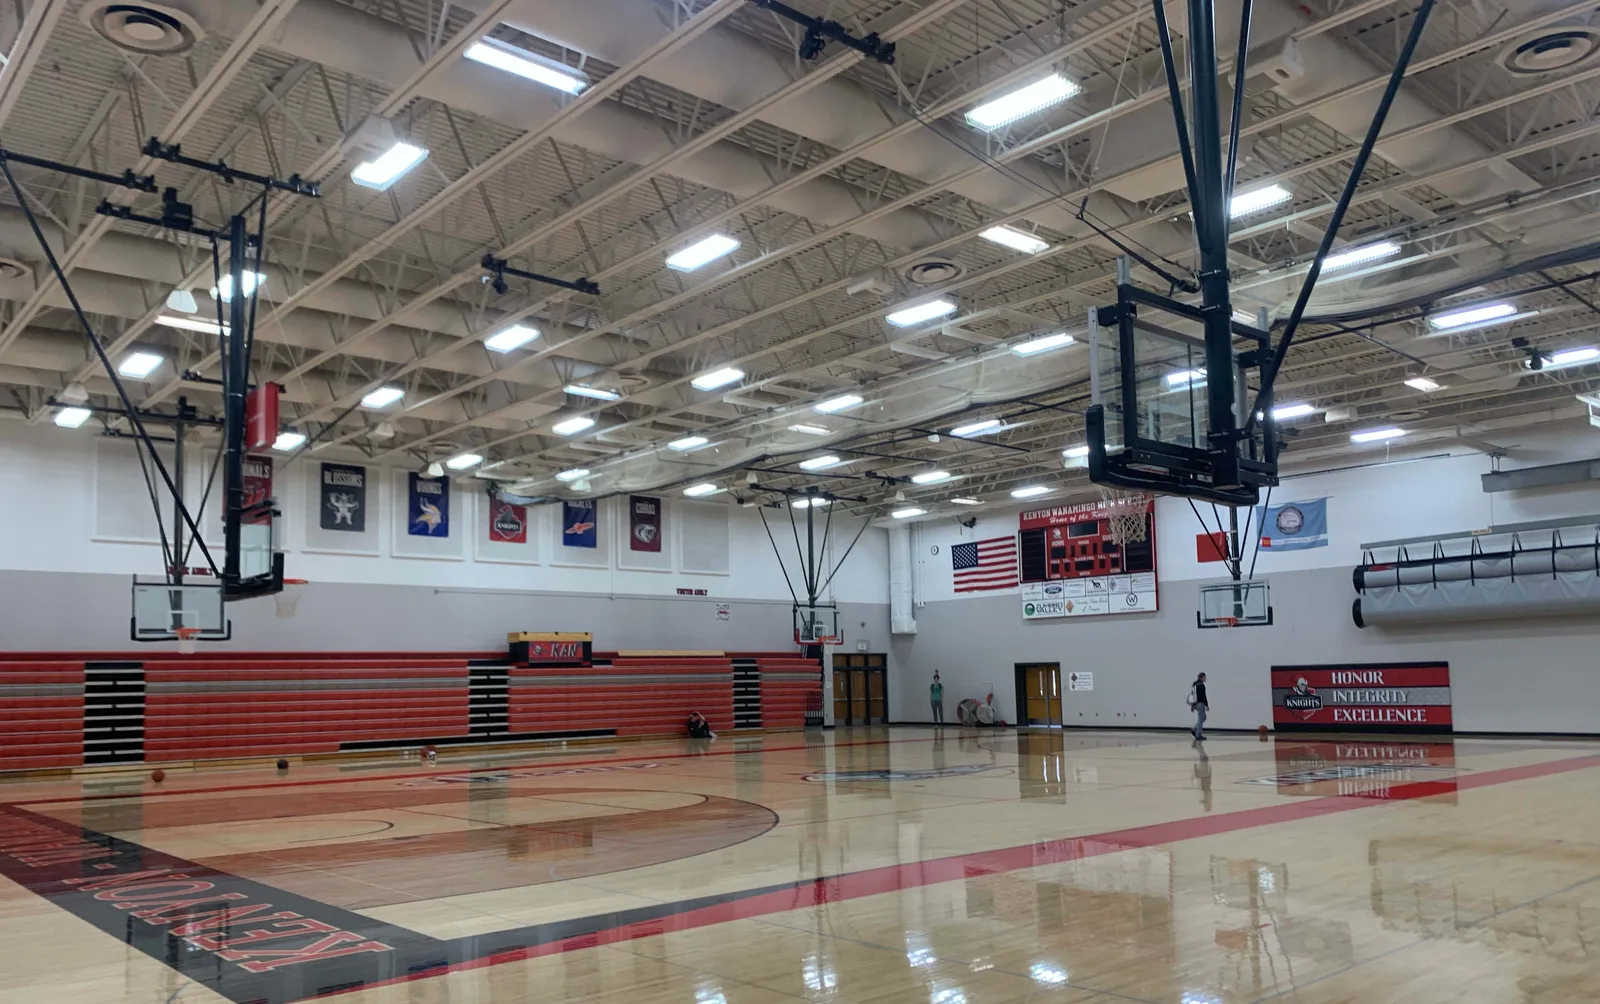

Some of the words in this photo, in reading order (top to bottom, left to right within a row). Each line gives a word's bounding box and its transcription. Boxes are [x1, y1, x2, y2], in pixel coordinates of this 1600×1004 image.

[1023, 508, 1051, 521] KENYON
[1052, 502, 1096, 517] WANAMINGO
[1049, 516, 1068, 525] Home
[1069, 514, 1077, 523] of
[1078, 512, 1089, 521] the
[497, 522, 519, 531] KNIGHTS
[550, 643, 577, 657] KAN
[1331, 671, 1384, 685] HONOR
[1286, 698, 1320, 708] KNIGHTS
[1332, 690, 1409, 704] INTEGRITY
[1333, 708, 1427, 722] EXCELLENCE
